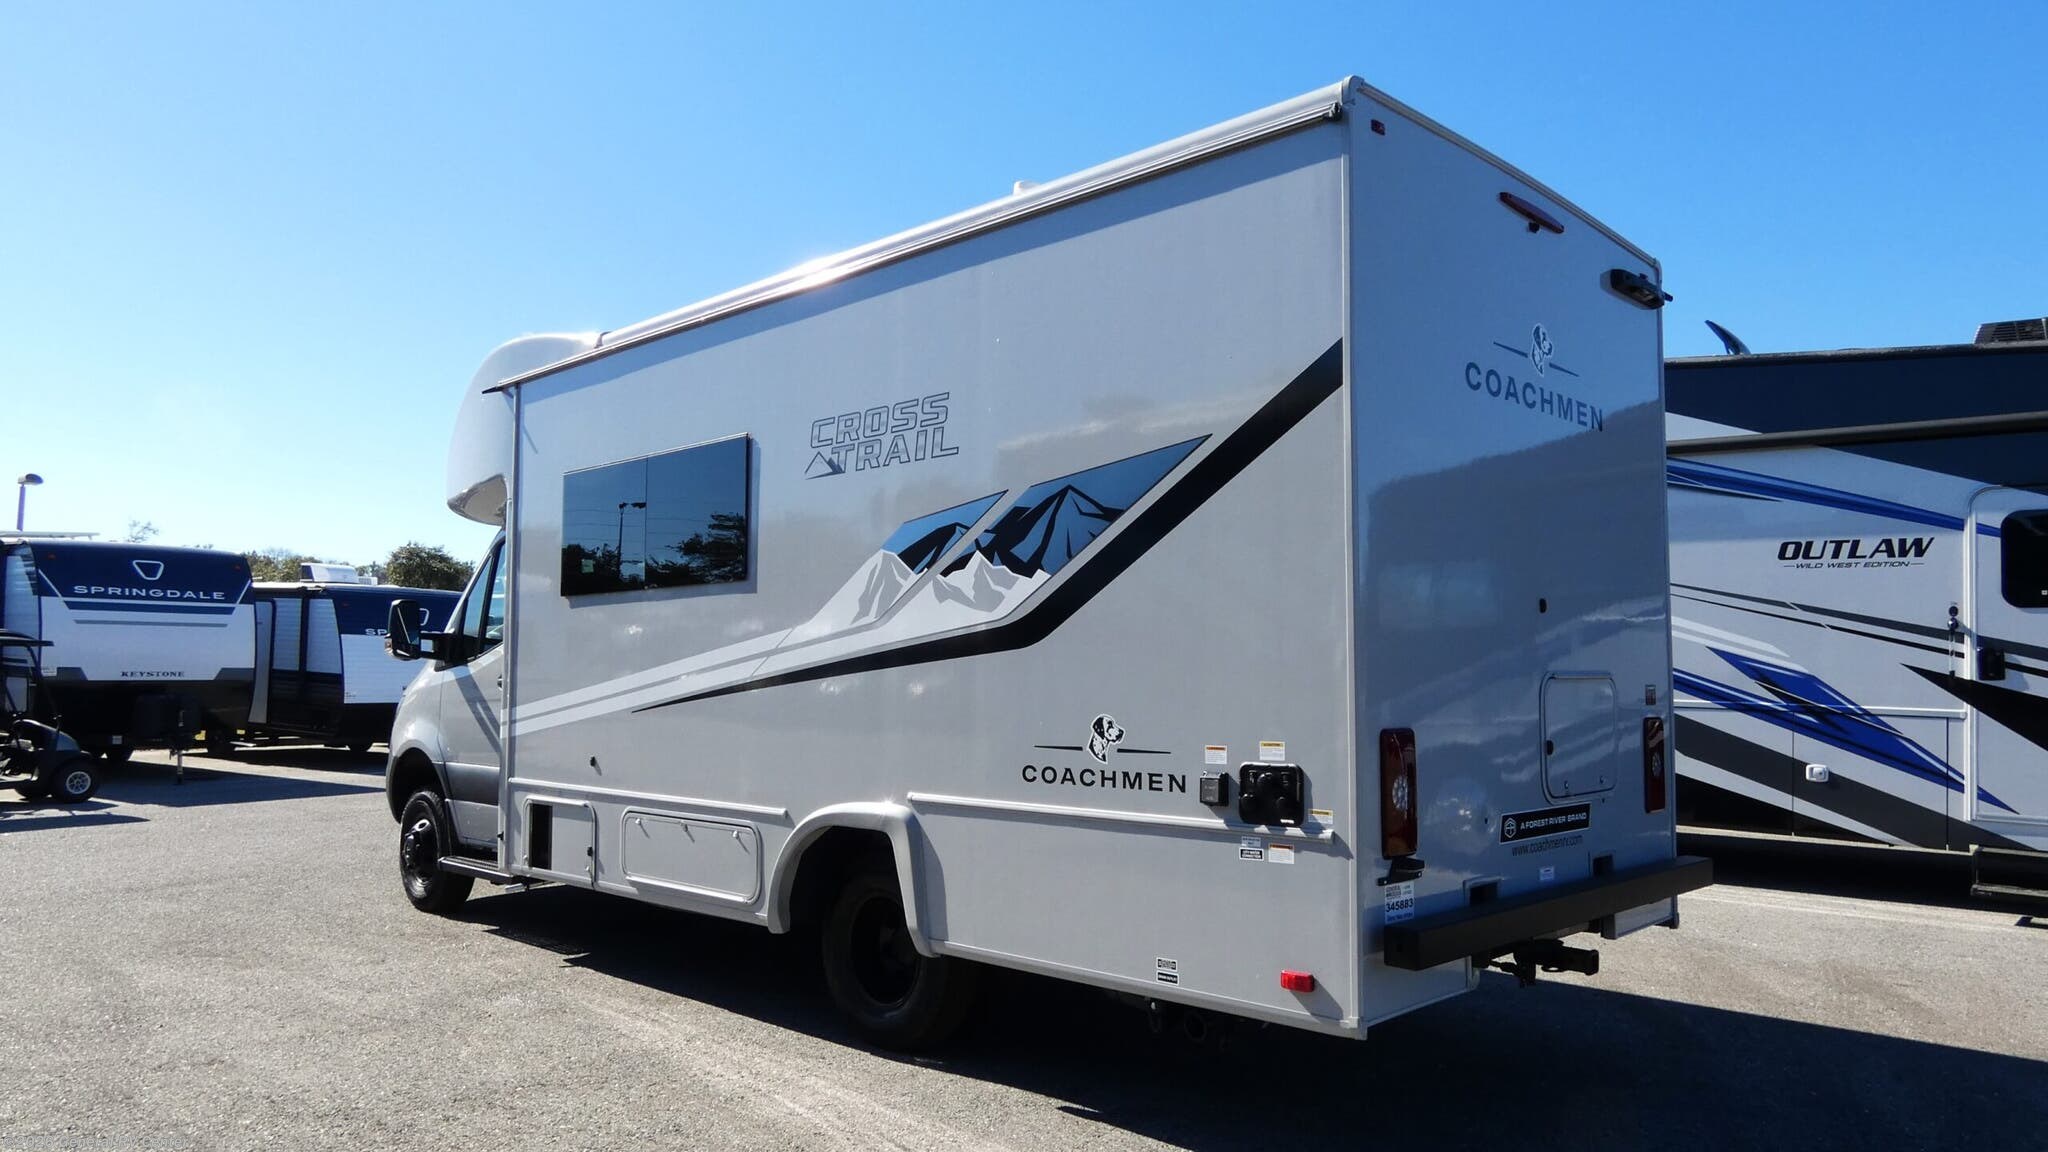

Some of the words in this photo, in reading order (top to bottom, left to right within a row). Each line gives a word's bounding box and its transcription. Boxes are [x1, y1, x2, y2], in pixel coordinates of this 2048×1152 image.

[1465, 362, 1603, 432] COACHMEN
[811, 391, 950, 448] CROSS
[832, 426, 959, 473] TRAIL
[1777, 537, 1935, 561] OUTLAW
[74, 585, 225, 600] SPRINGDALE
[1022, 764, 1187, 793] COACHMEN
[1526, 817, 1548, 829] FOREST
[1549, 815, 1566, 825] RIVER
[1567, 812, 1587, 822] BRAND
